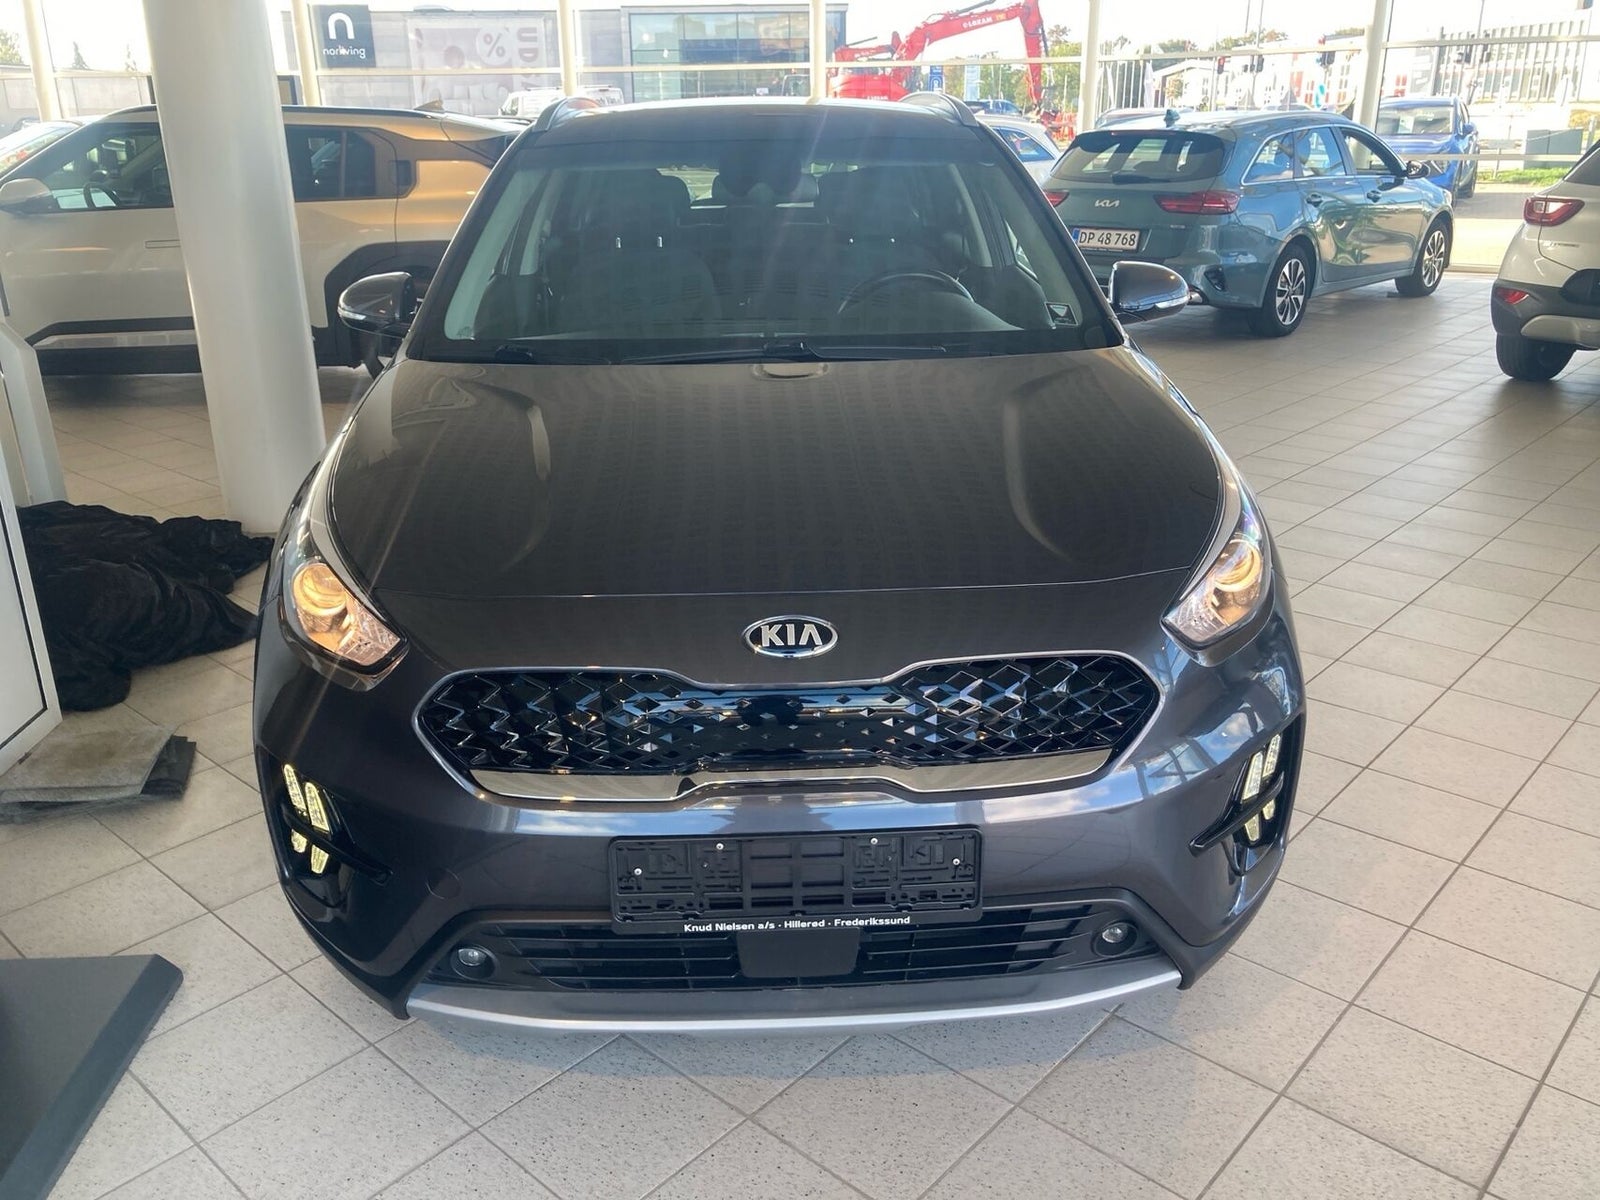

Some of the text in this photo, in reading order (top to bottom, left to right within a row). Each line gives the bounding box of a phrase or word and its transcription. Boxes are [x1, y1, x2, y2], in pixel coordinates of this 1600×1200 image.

[328, 12, 355, 39] n
[483, 33, 506, 58] %
[1094, 199, 1120, 208] KIA
[1079, 231, 1136, 247] DP 48 768
[761, 623, 823, 647] KIA
[684, 923, 712, 932] Knud
[715, 922, 755, 931] Nielsen
[757, 920, 775, 930] a/s
[784, 919, 825, 929] Hillerød
[834, 916, 911, 927] Frederikssund
